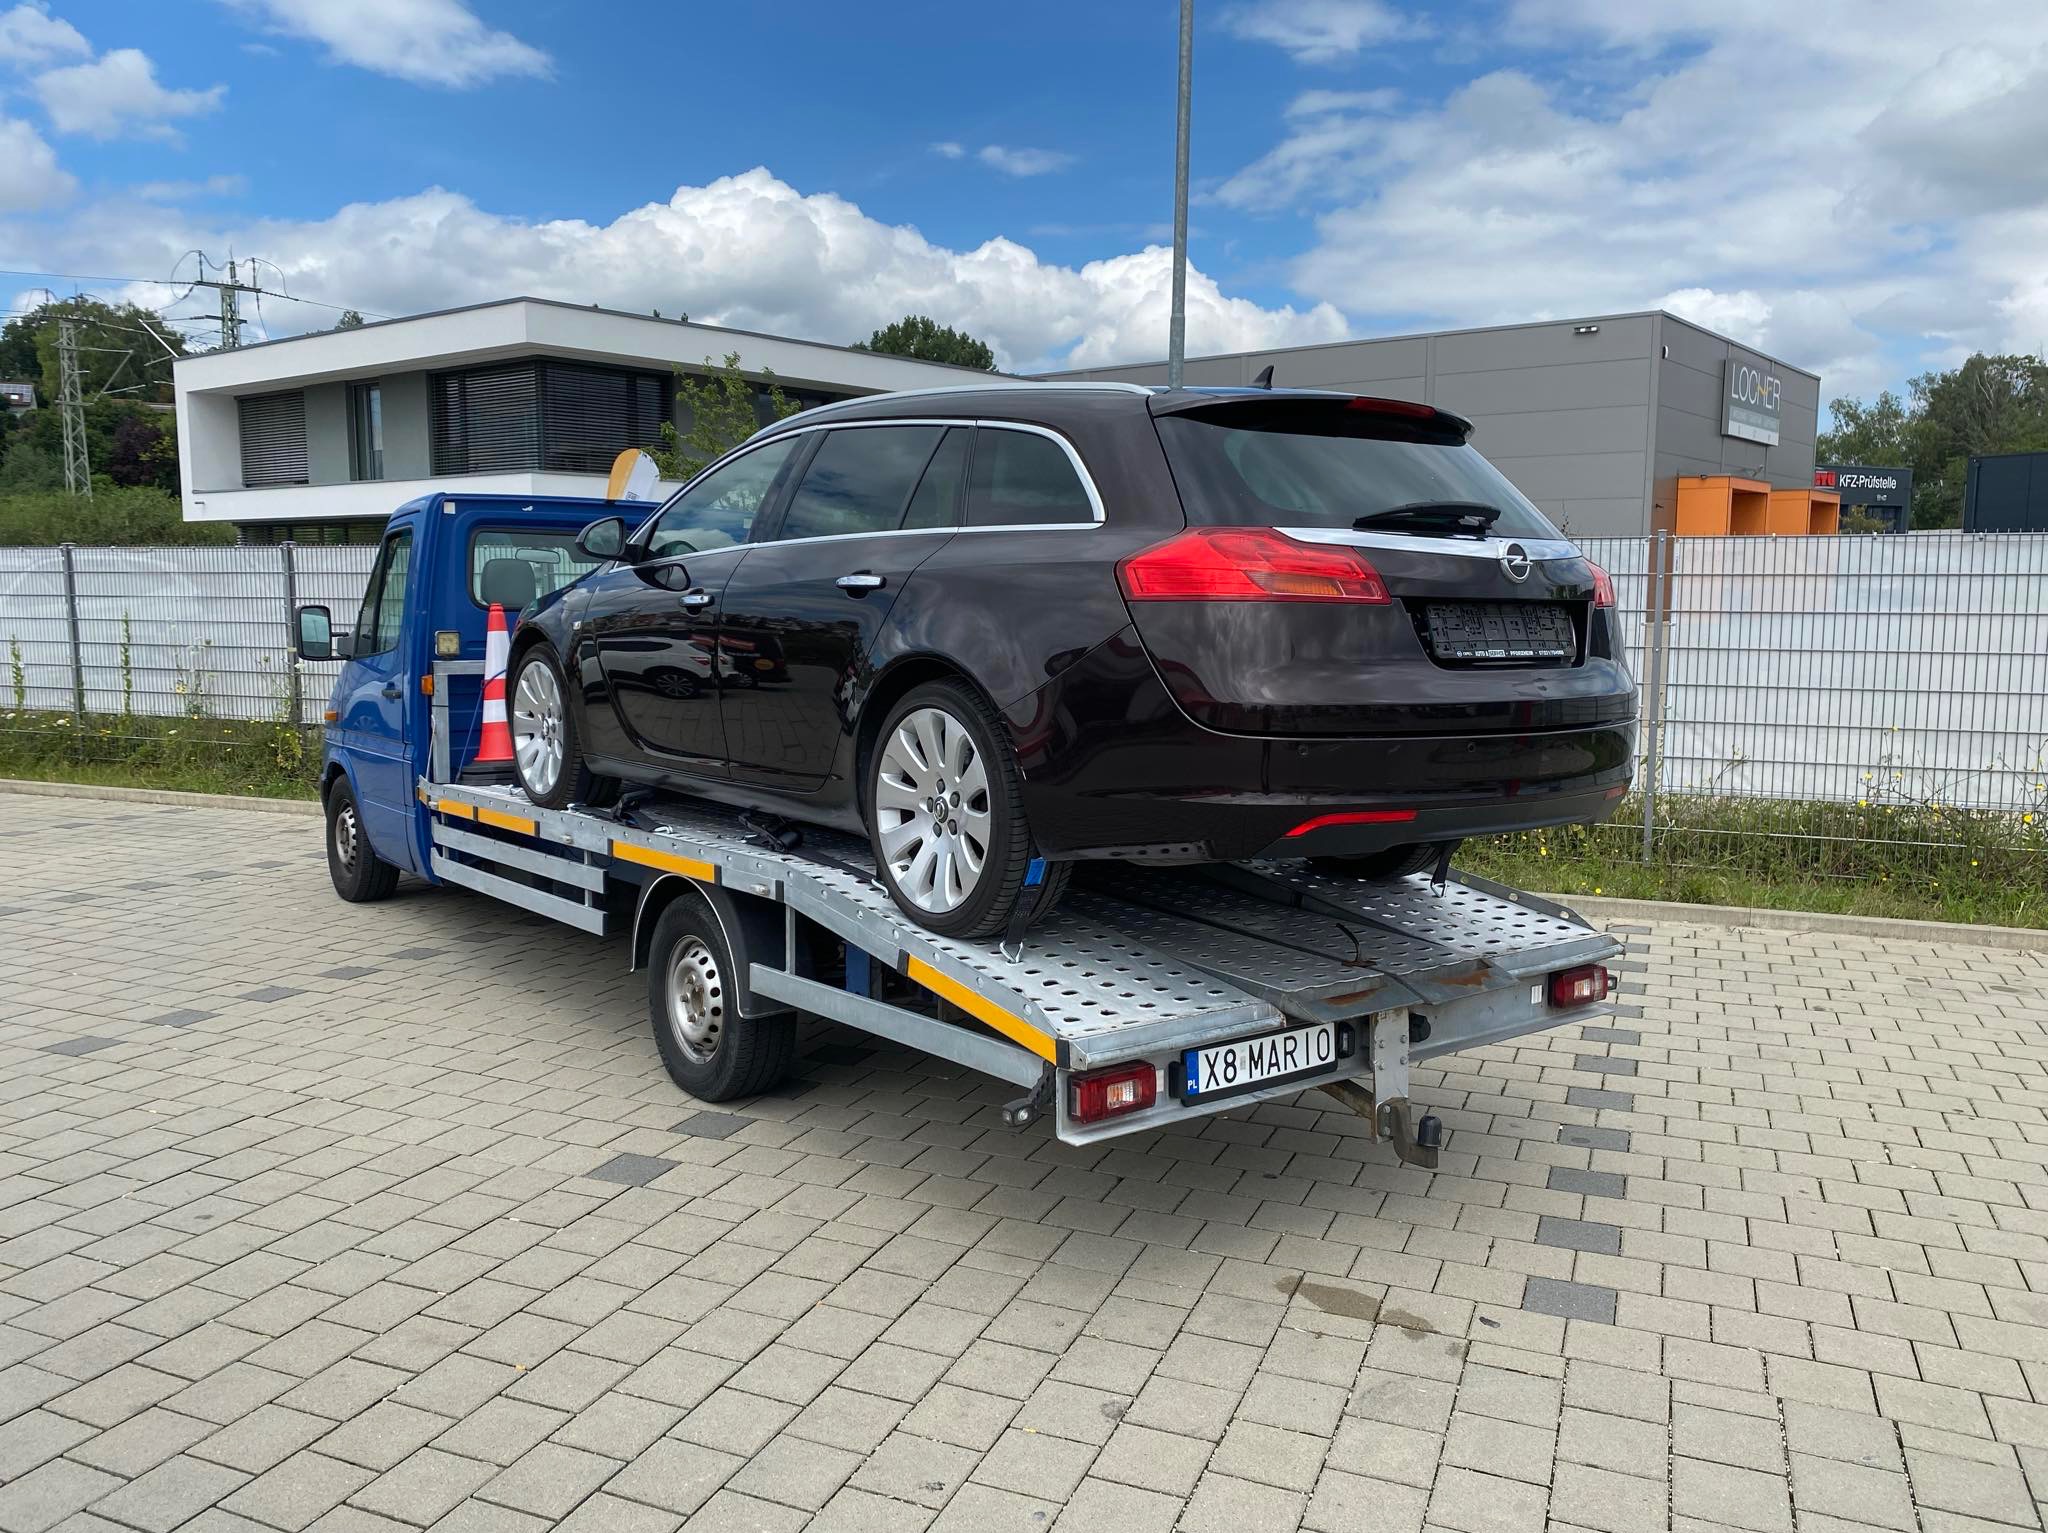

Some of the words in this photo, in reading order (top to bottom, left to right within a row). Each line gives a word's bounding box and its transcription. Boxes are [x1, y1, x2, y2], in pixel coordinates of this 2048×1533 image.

[1732, 363, 1780, 412] LOCHER
[1840, 474, 1897, 489] KFZ-Prüfstelle
[1205, 1048, 1237, 1089] X8
[1249, 1028, 1330, 1079] MARIO
[1188, 1079, 1198, 1091] PL
